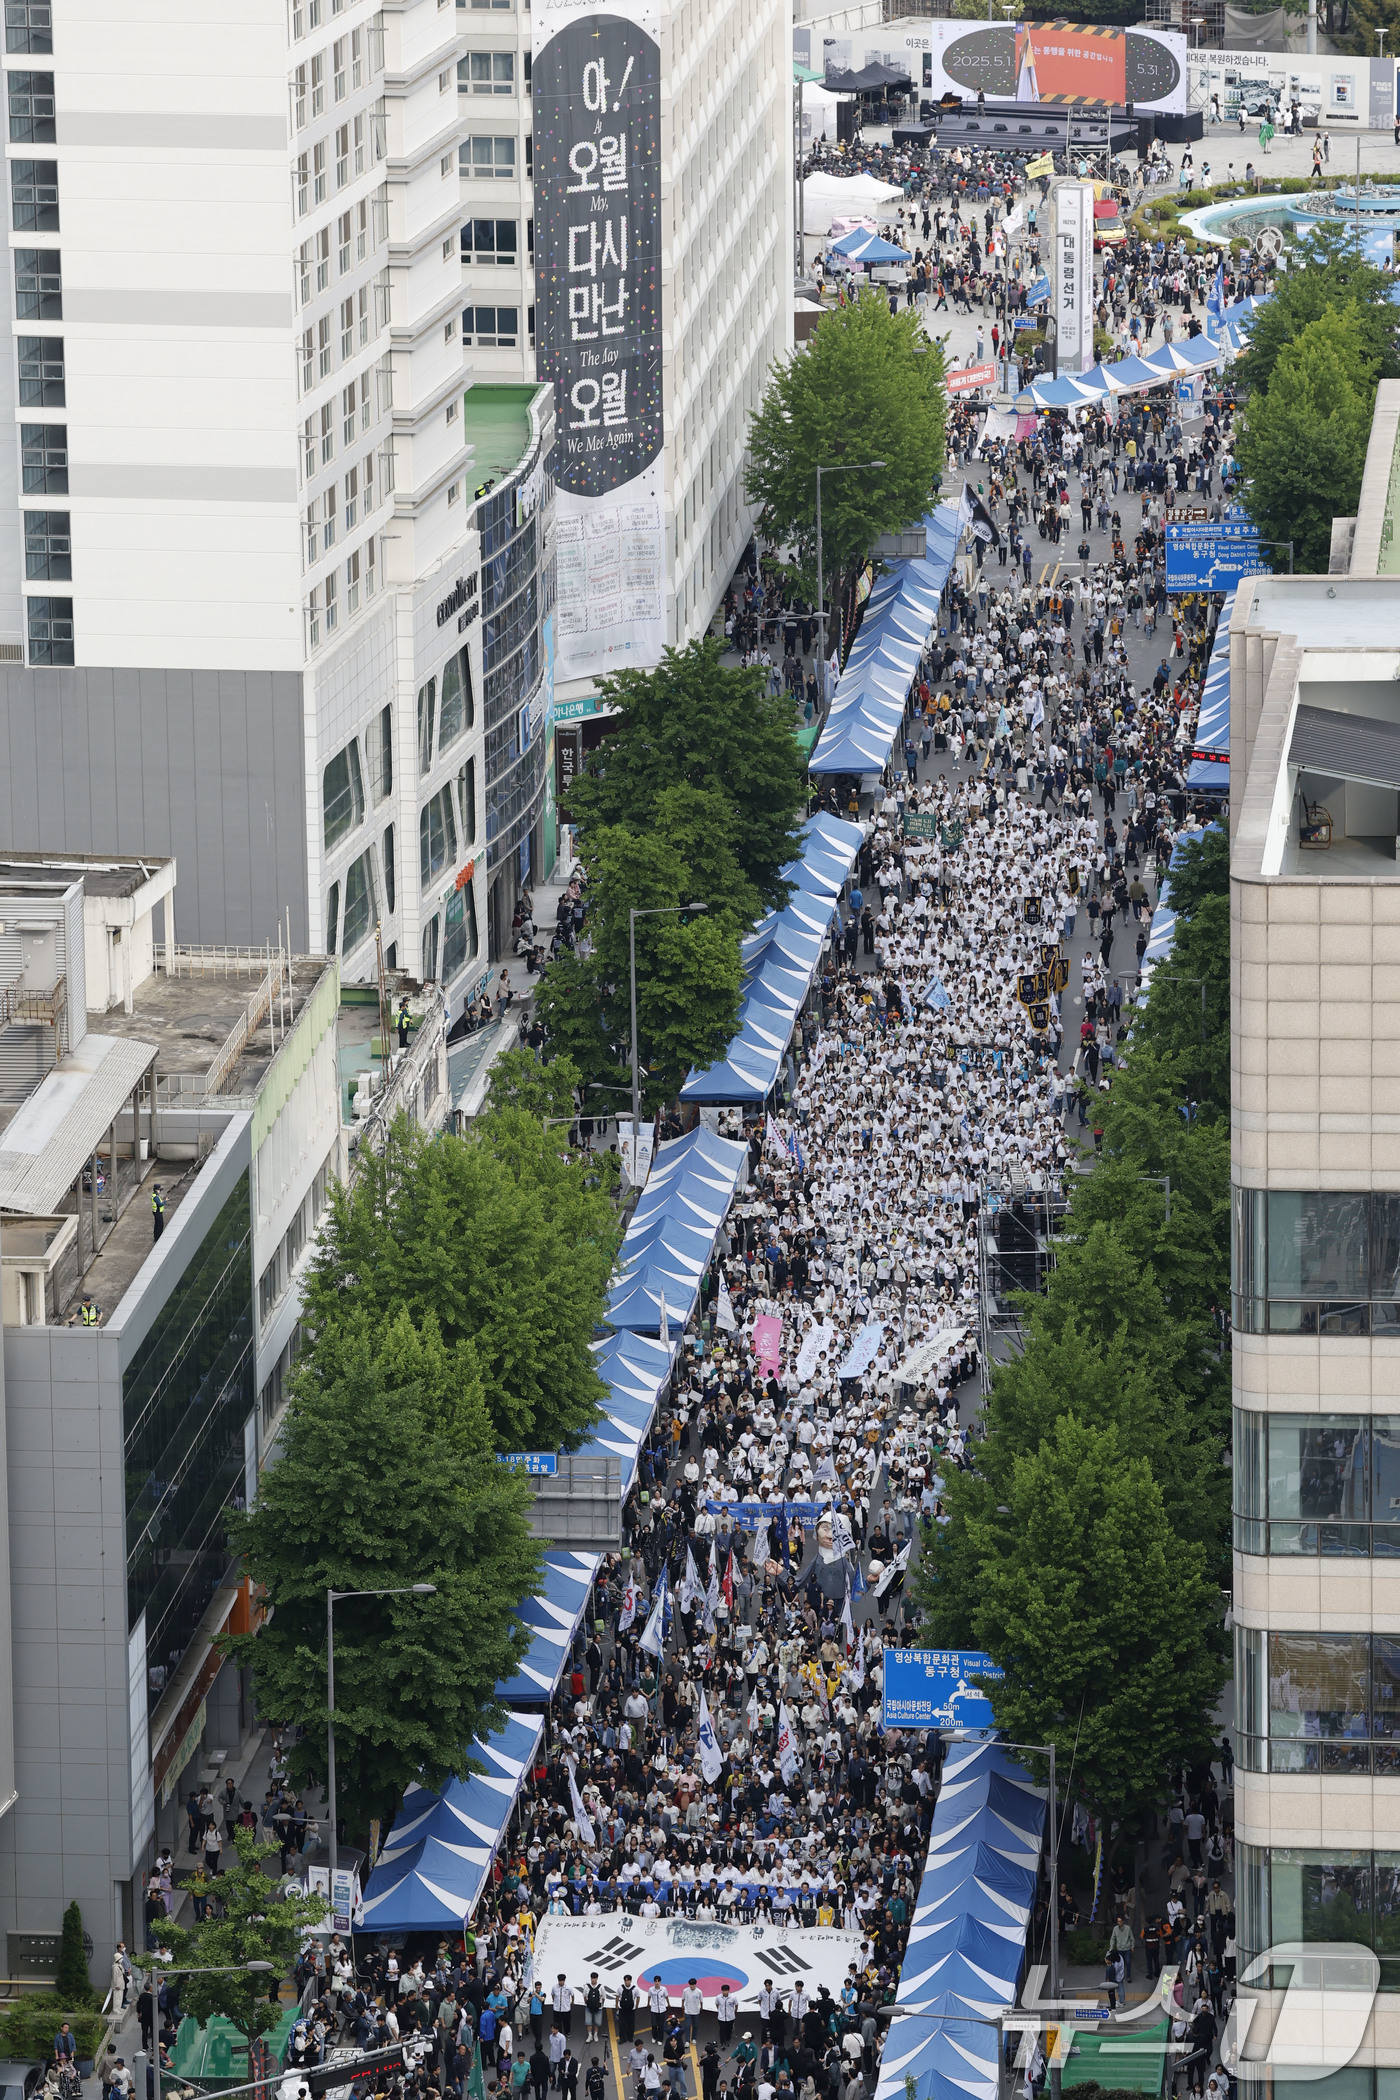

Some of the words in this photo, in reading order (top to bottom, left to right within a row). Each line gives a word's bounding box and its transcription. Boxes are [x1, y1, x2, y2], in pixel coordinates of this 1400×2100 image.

[906, 38, 930, 48] 이곳은
[1043, 46, 1066, 56] 통행을
[1067, 48, 1082, 58] 위한
[1083, 50, 1114, 64] 공간입니다
[1209, 54, 1269, 66] 복원하겠습니다.
[582, 56, 634, 114] 아!
[1369, 113, 1393, 129] 518
[566, 133, 628, 193] 오월
[568, 216, 628, 277] 다시
[1063, 236, 1074, 310] 대통령선거
[568, 278, 629, 340] 만난
[580, 350, 600, 367] The
[967, 370, 991, 384] 대한민국!
[570, 368, 628, 429] 오월
[567, 438, 583, 454] We
[605, 428, 634, 450] Again
[1173, 542, 1216, 551] 영상복합문화관
[1193, 550, 1215, 559] 동구청
[894, 1652, 959, 1666] 영상복합문화관
[925, 1666, 959, 1678] 동구청
[887, 1700, 932, 1712] 국립아시아문화전당
[943, 1703, 960, 1711] 50m
[940, 1718, 963, 1726] 200m
